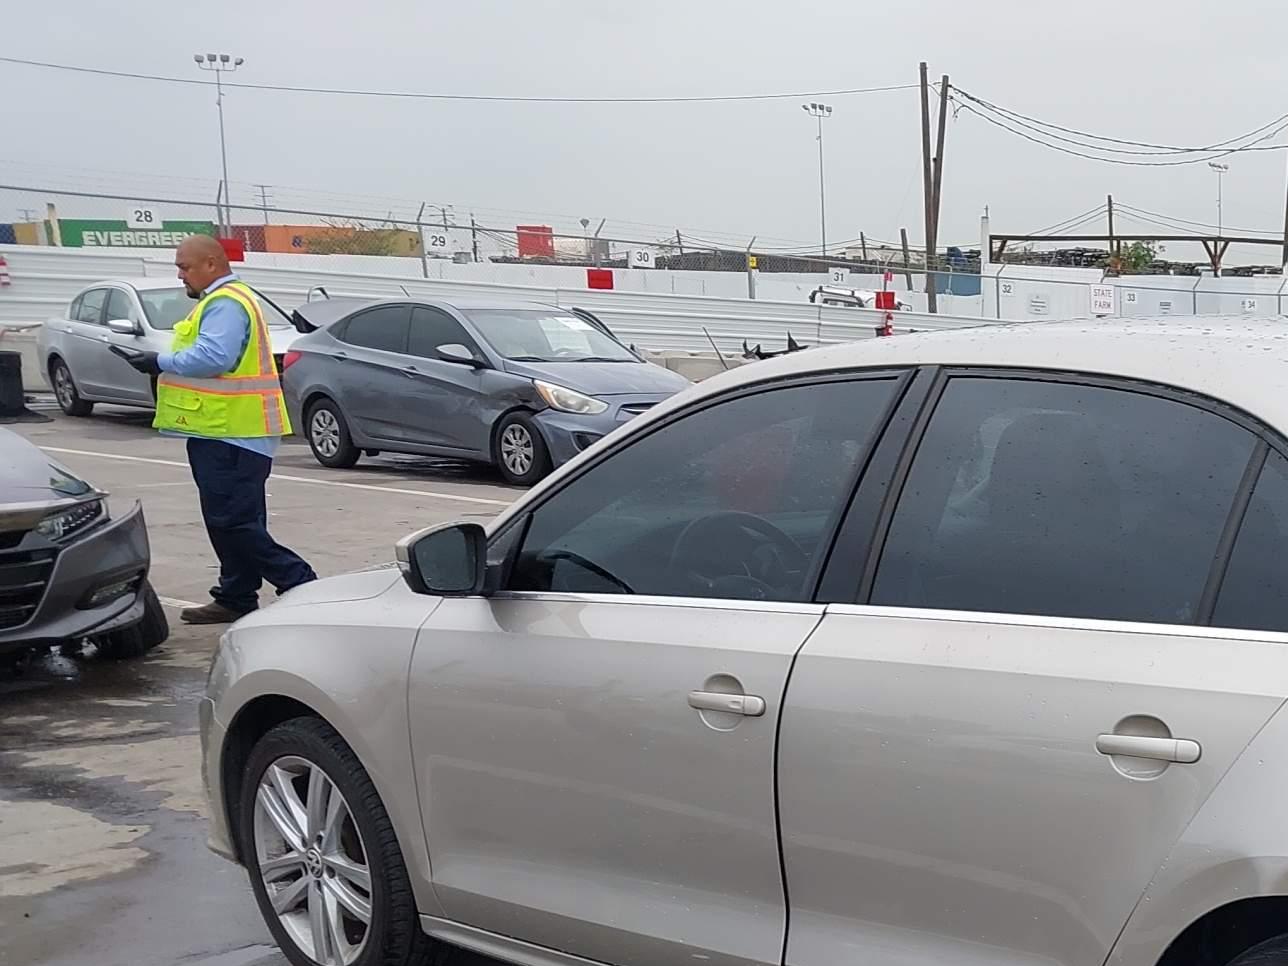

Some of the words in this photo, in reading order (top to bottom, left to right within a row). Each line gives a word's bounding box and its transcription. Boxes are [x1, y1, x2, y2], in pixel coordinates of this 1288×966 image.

[134, 210, 153, 223] 28
[431, 235, 446, 248] 29
[636, 252, 650, 263] 30
[833, 272, 845, 282] 31
[1002, 284, 1012, 294] 32
[1093, 289, 1113, 298] STATE
[1127, 293, 1136, 302] 33
[1094, 301, 1112, 310] FARM
